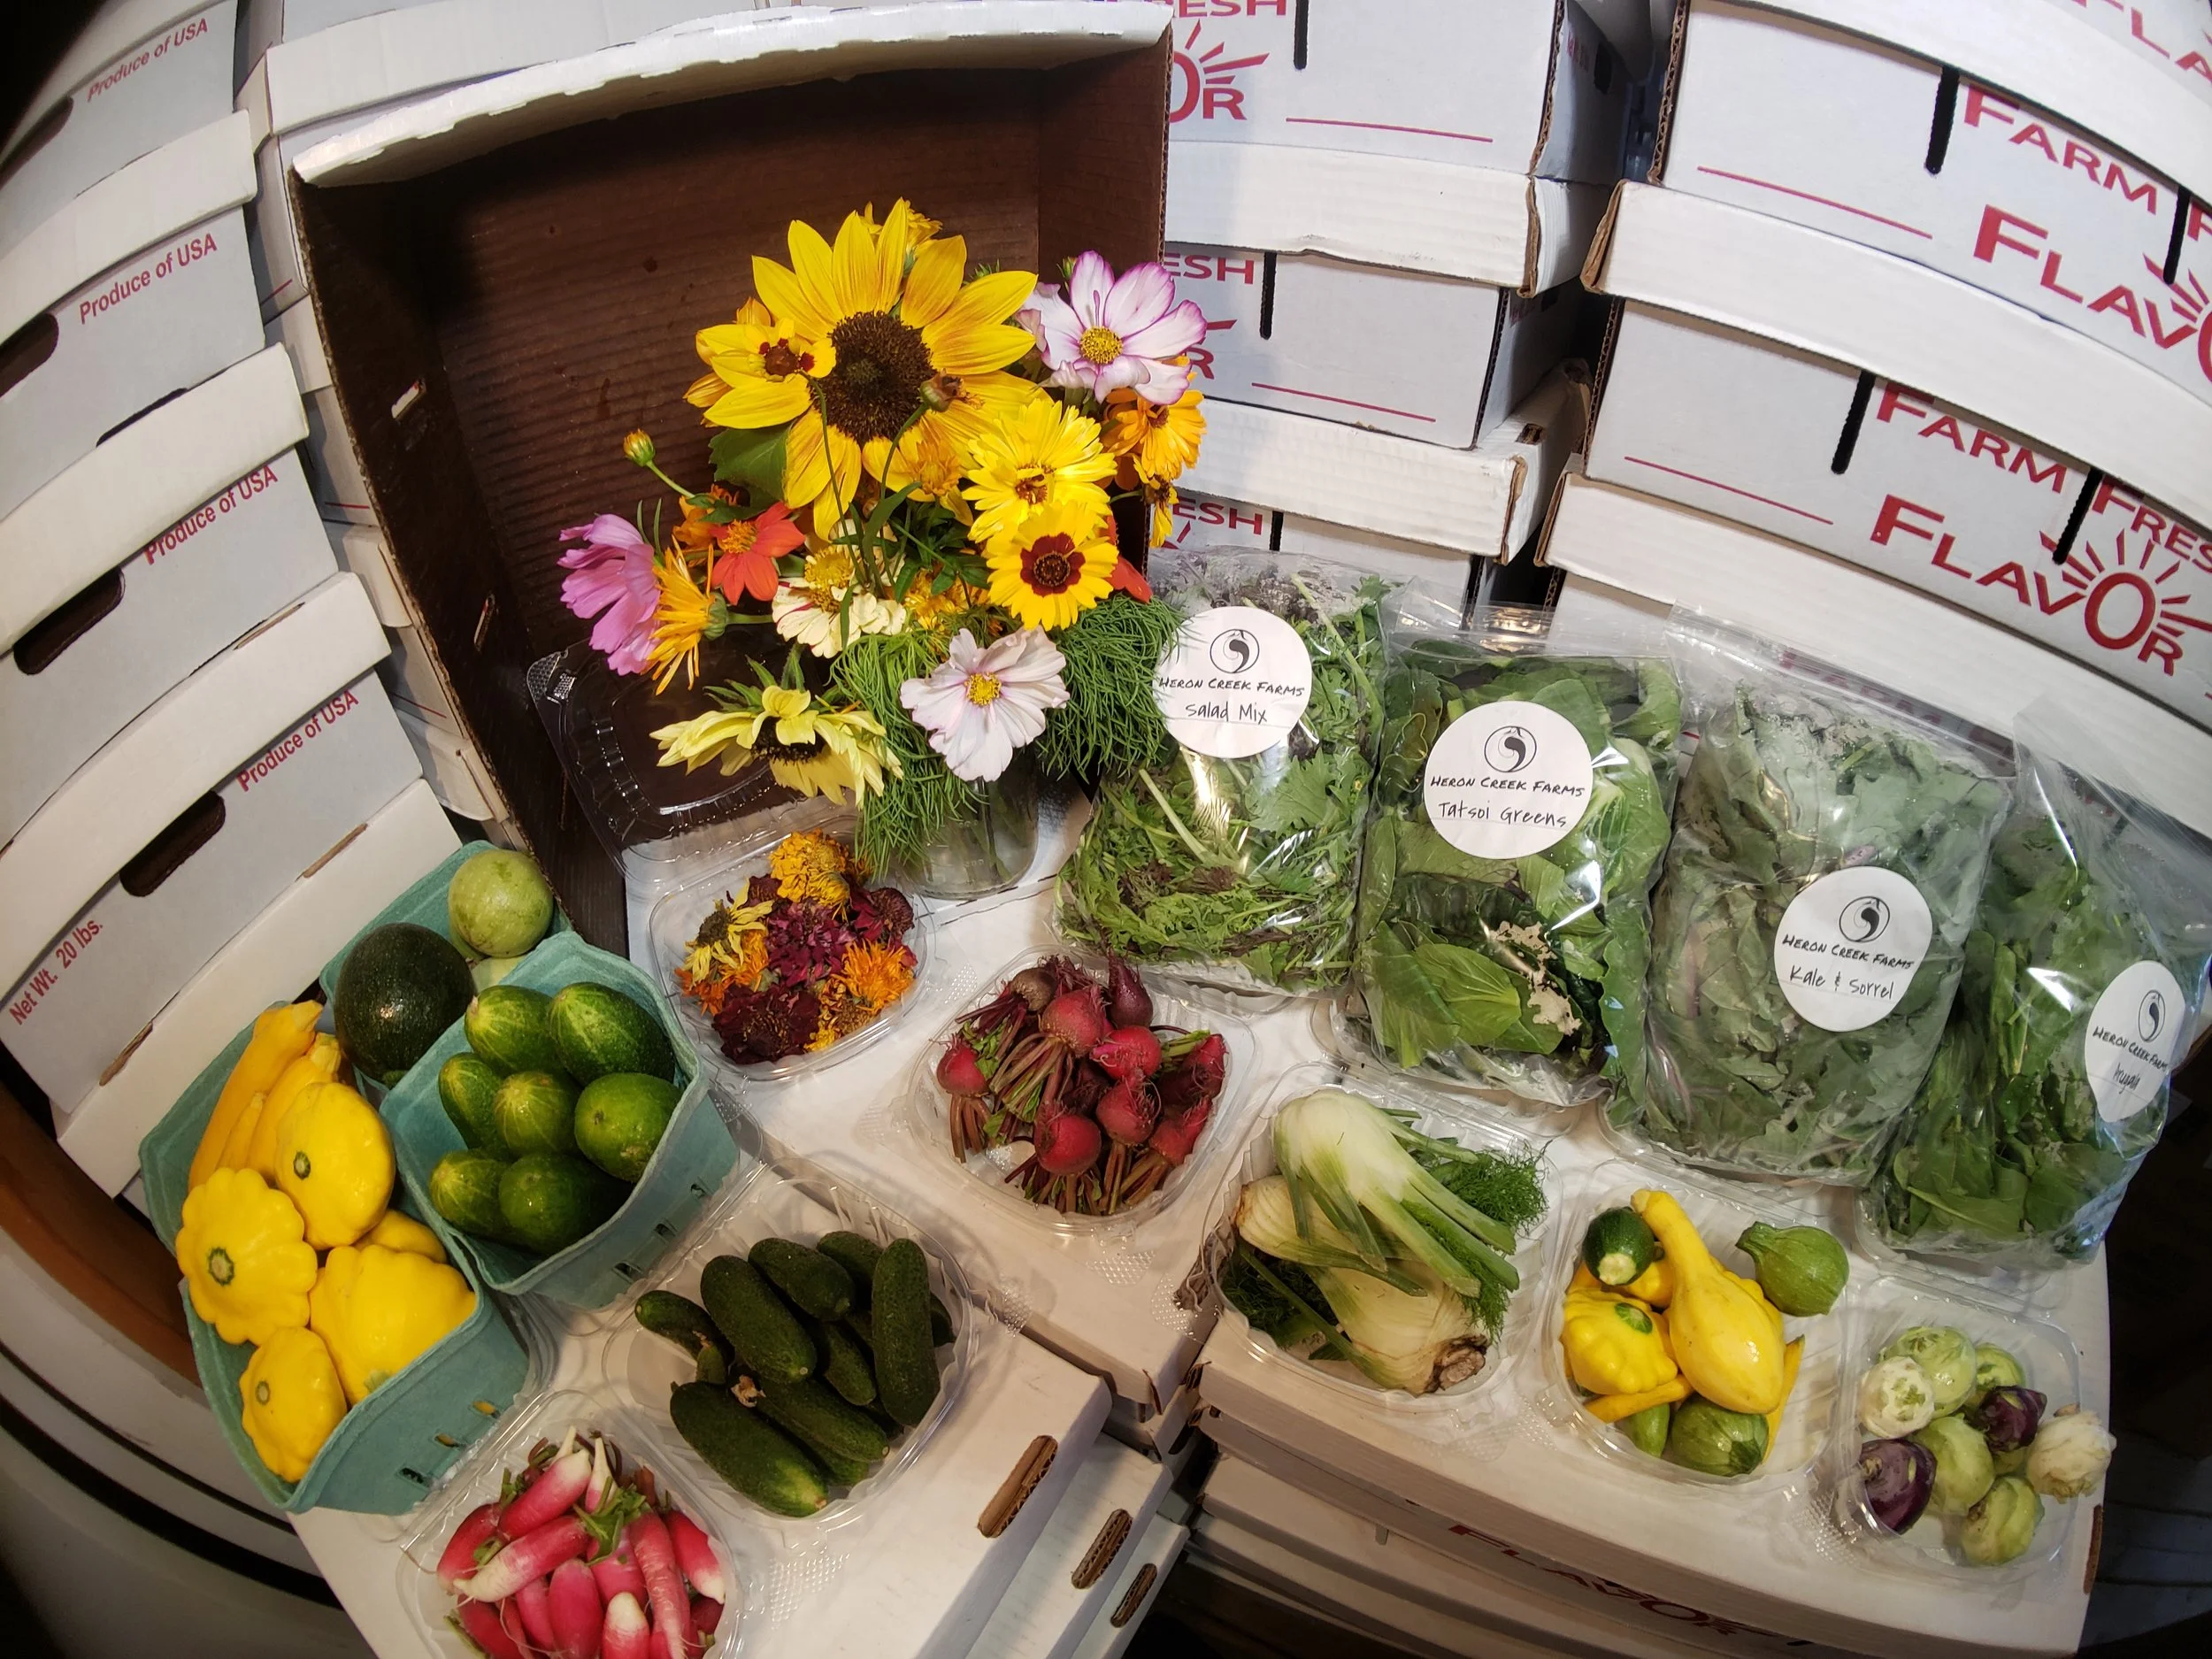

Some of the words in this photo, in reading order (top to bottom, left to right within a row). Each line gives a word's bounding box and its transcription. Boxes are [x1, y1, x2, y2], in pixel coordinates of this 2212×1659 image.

[88, 51, 150, 103] Produce
[154, 35, 172, 58] of
[174, 18, 208, 46] USA
[1964, 85, 2157, 215] FARM
[80, 270, 150, 325] Produce
[156, 251, 173, 279] of
[177, 233, 218, 266] USA
[1974, 204, 2212, 382] FLAV
[1877, 381, 2068, 494] FARM
[144, 506, 216, 565] Produce
[219, 487, 236, 513] of
[236, 465, 278, 500] USA
[1172, 495, 1263, 536] ESH
[1870, 494, 2184, 677] FLAVOR
[1158, 677, 1203, 688] HERON
[1208, 678, 1252, 690] CREEK
[1256, 681, 1305, 697] FARMS
[1239, 702, 1267, 726] Mix
[236, 733, 303, 792] Produce
[304, 713, 322, 738] of
[319, 689, 359, 724] USA
[1430, 775, 1476, 787] HERON
[1480, 777, 1527, 790] CREEK
[1532, 780, 1586, 797] FARMS
[1439, 800, 1490, 819] Tatsoi
[1500, 806, 1567, 828] Greens
[9, 990, 38, 1025] Net
[29, 969, 58, 997] Wt.
[55, 941, 78, 969] 20
[72, 919, 104, 949] lbs.
[1782, 933, 1827, 953] HERON
[1831, 944, 1870, 962] CREEK
[1872, 953, 1915, 970] FARMS
[1790, 964, 1826, 987] Kale
[2093, 1025, 2129, 1048] HERON
[2128, 1041, 2151, 1062] CREEK
